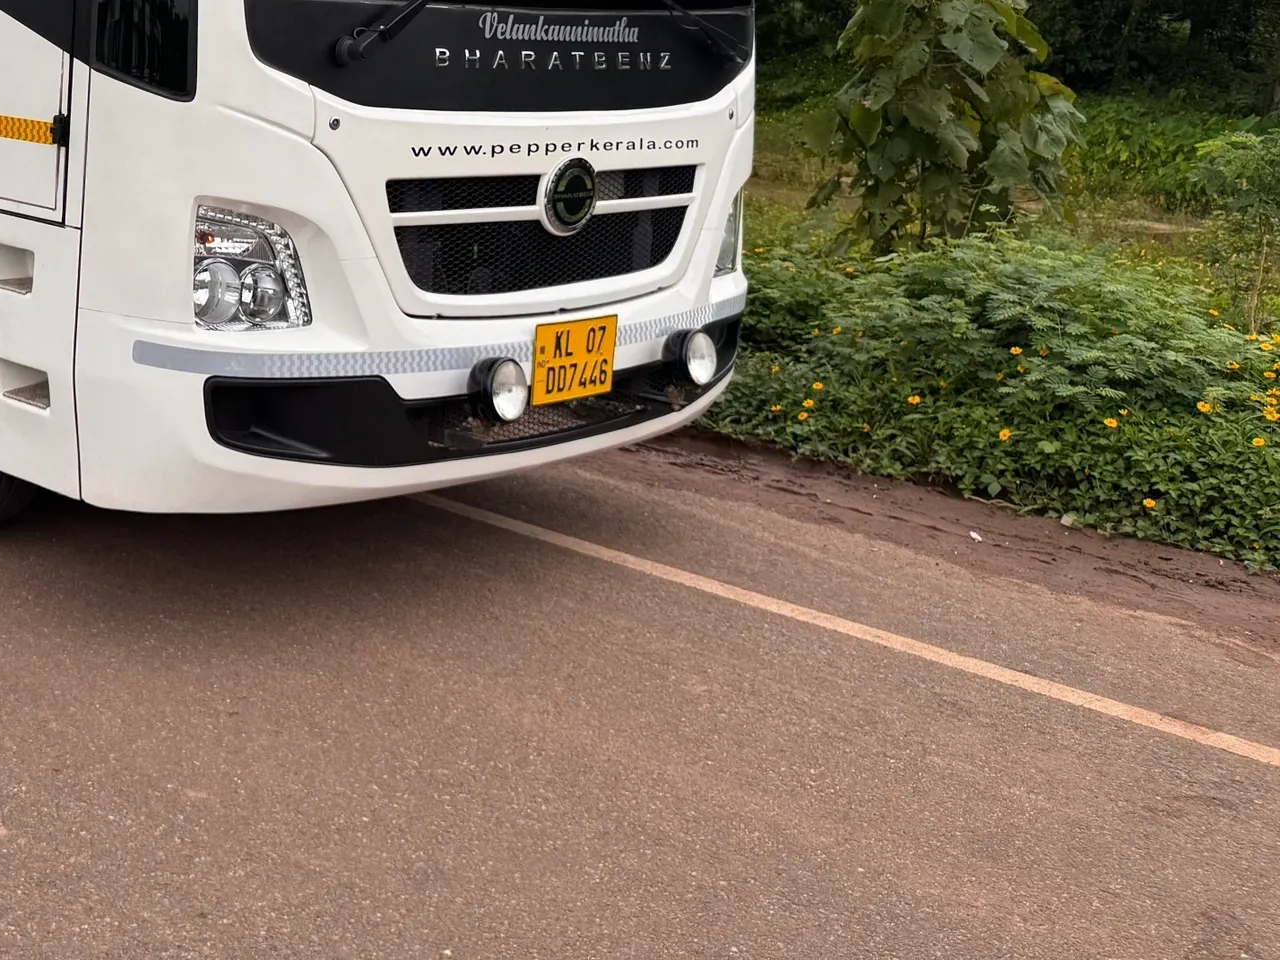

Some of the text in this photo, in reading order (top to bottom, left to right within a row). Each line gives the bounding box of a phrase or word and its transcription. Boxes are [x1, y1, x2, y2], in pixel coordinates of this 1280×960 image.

[478, 12, 639, 43] Velankannimatha
[435, 47, 672, 71] BHARATBENZ
[411, 137, 700, 159] www.pepperkerala.com
[553, 325, 607, 359] KL 07
[545, 357, 608, 395] DD7446
